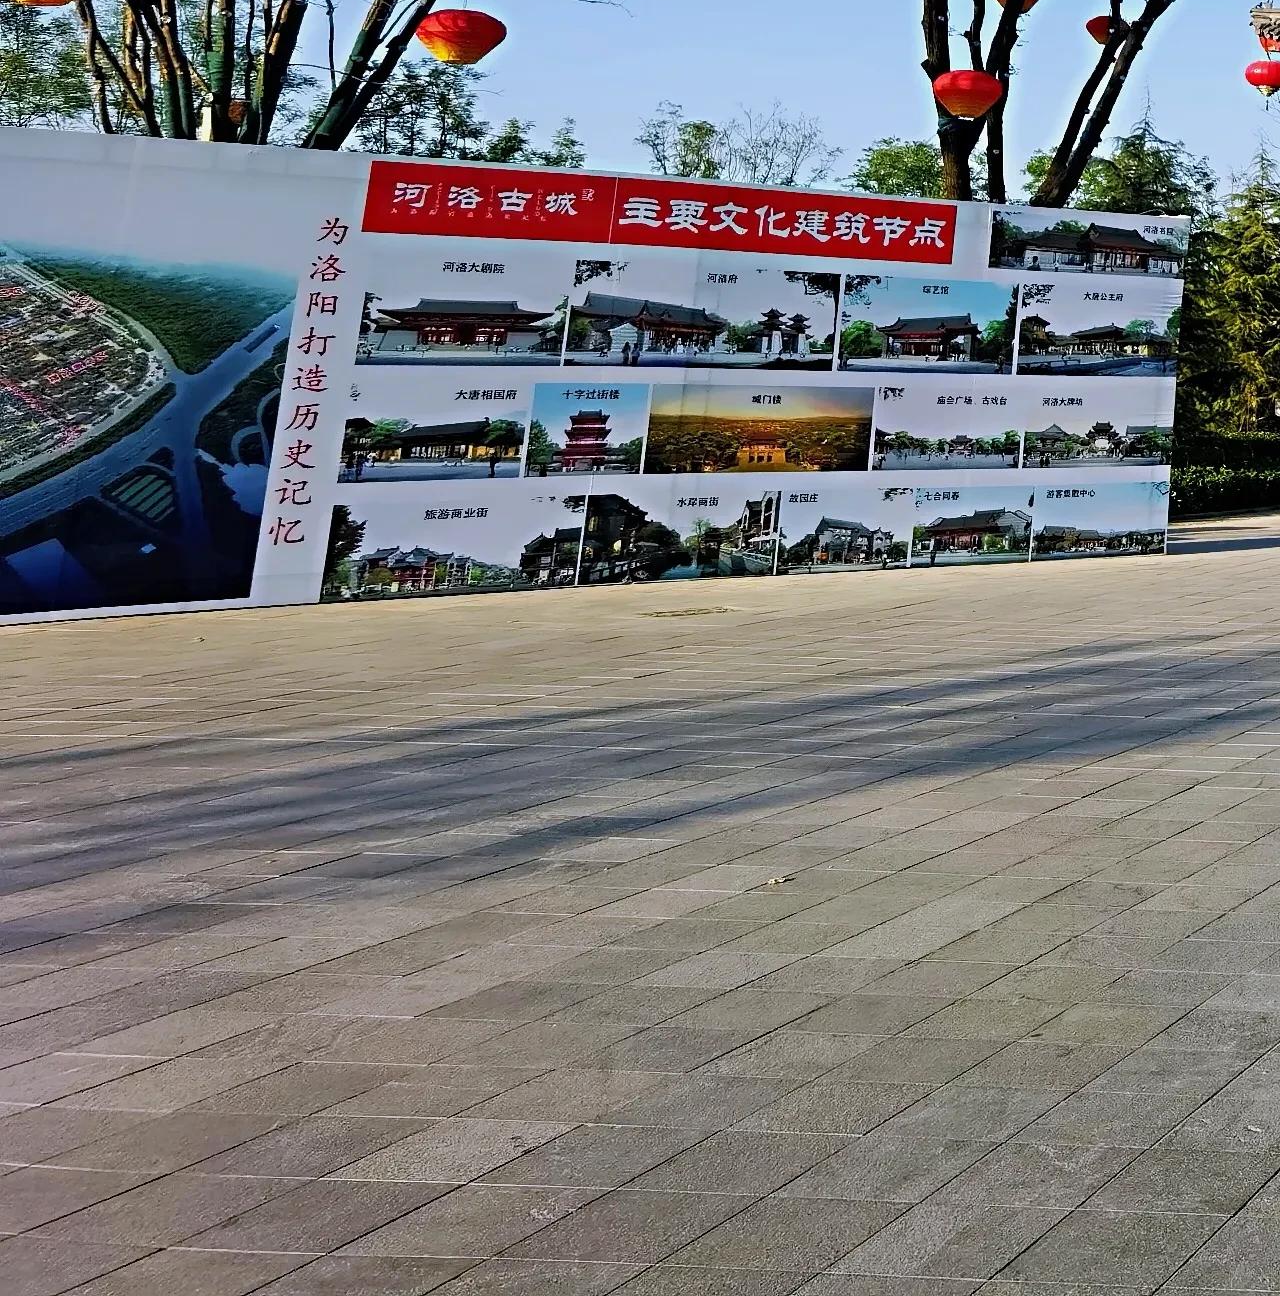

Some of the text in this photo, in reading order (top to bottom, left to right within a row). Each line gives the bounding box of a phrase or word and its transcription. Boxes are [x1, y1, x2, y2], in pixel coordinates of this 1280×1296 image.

[393, 182, 578, 216] 河洛古城
[618, 197, 947, 248] 主要文化建筑节点
[442, 261, 505, 275] 河洛大剧院
[268, 217, 350, 546] 为洛阳打造历史记忆
[454, 389, 517, 401] 大唐相国府
[562, 389, 620, 401] 十字过街楼
[1042, 396, 1083, 407] 河洛大牌坊
[1046, 489, 1096, 500] 游客集散中心
[424, 508, 488, 521] 旅游商业街
